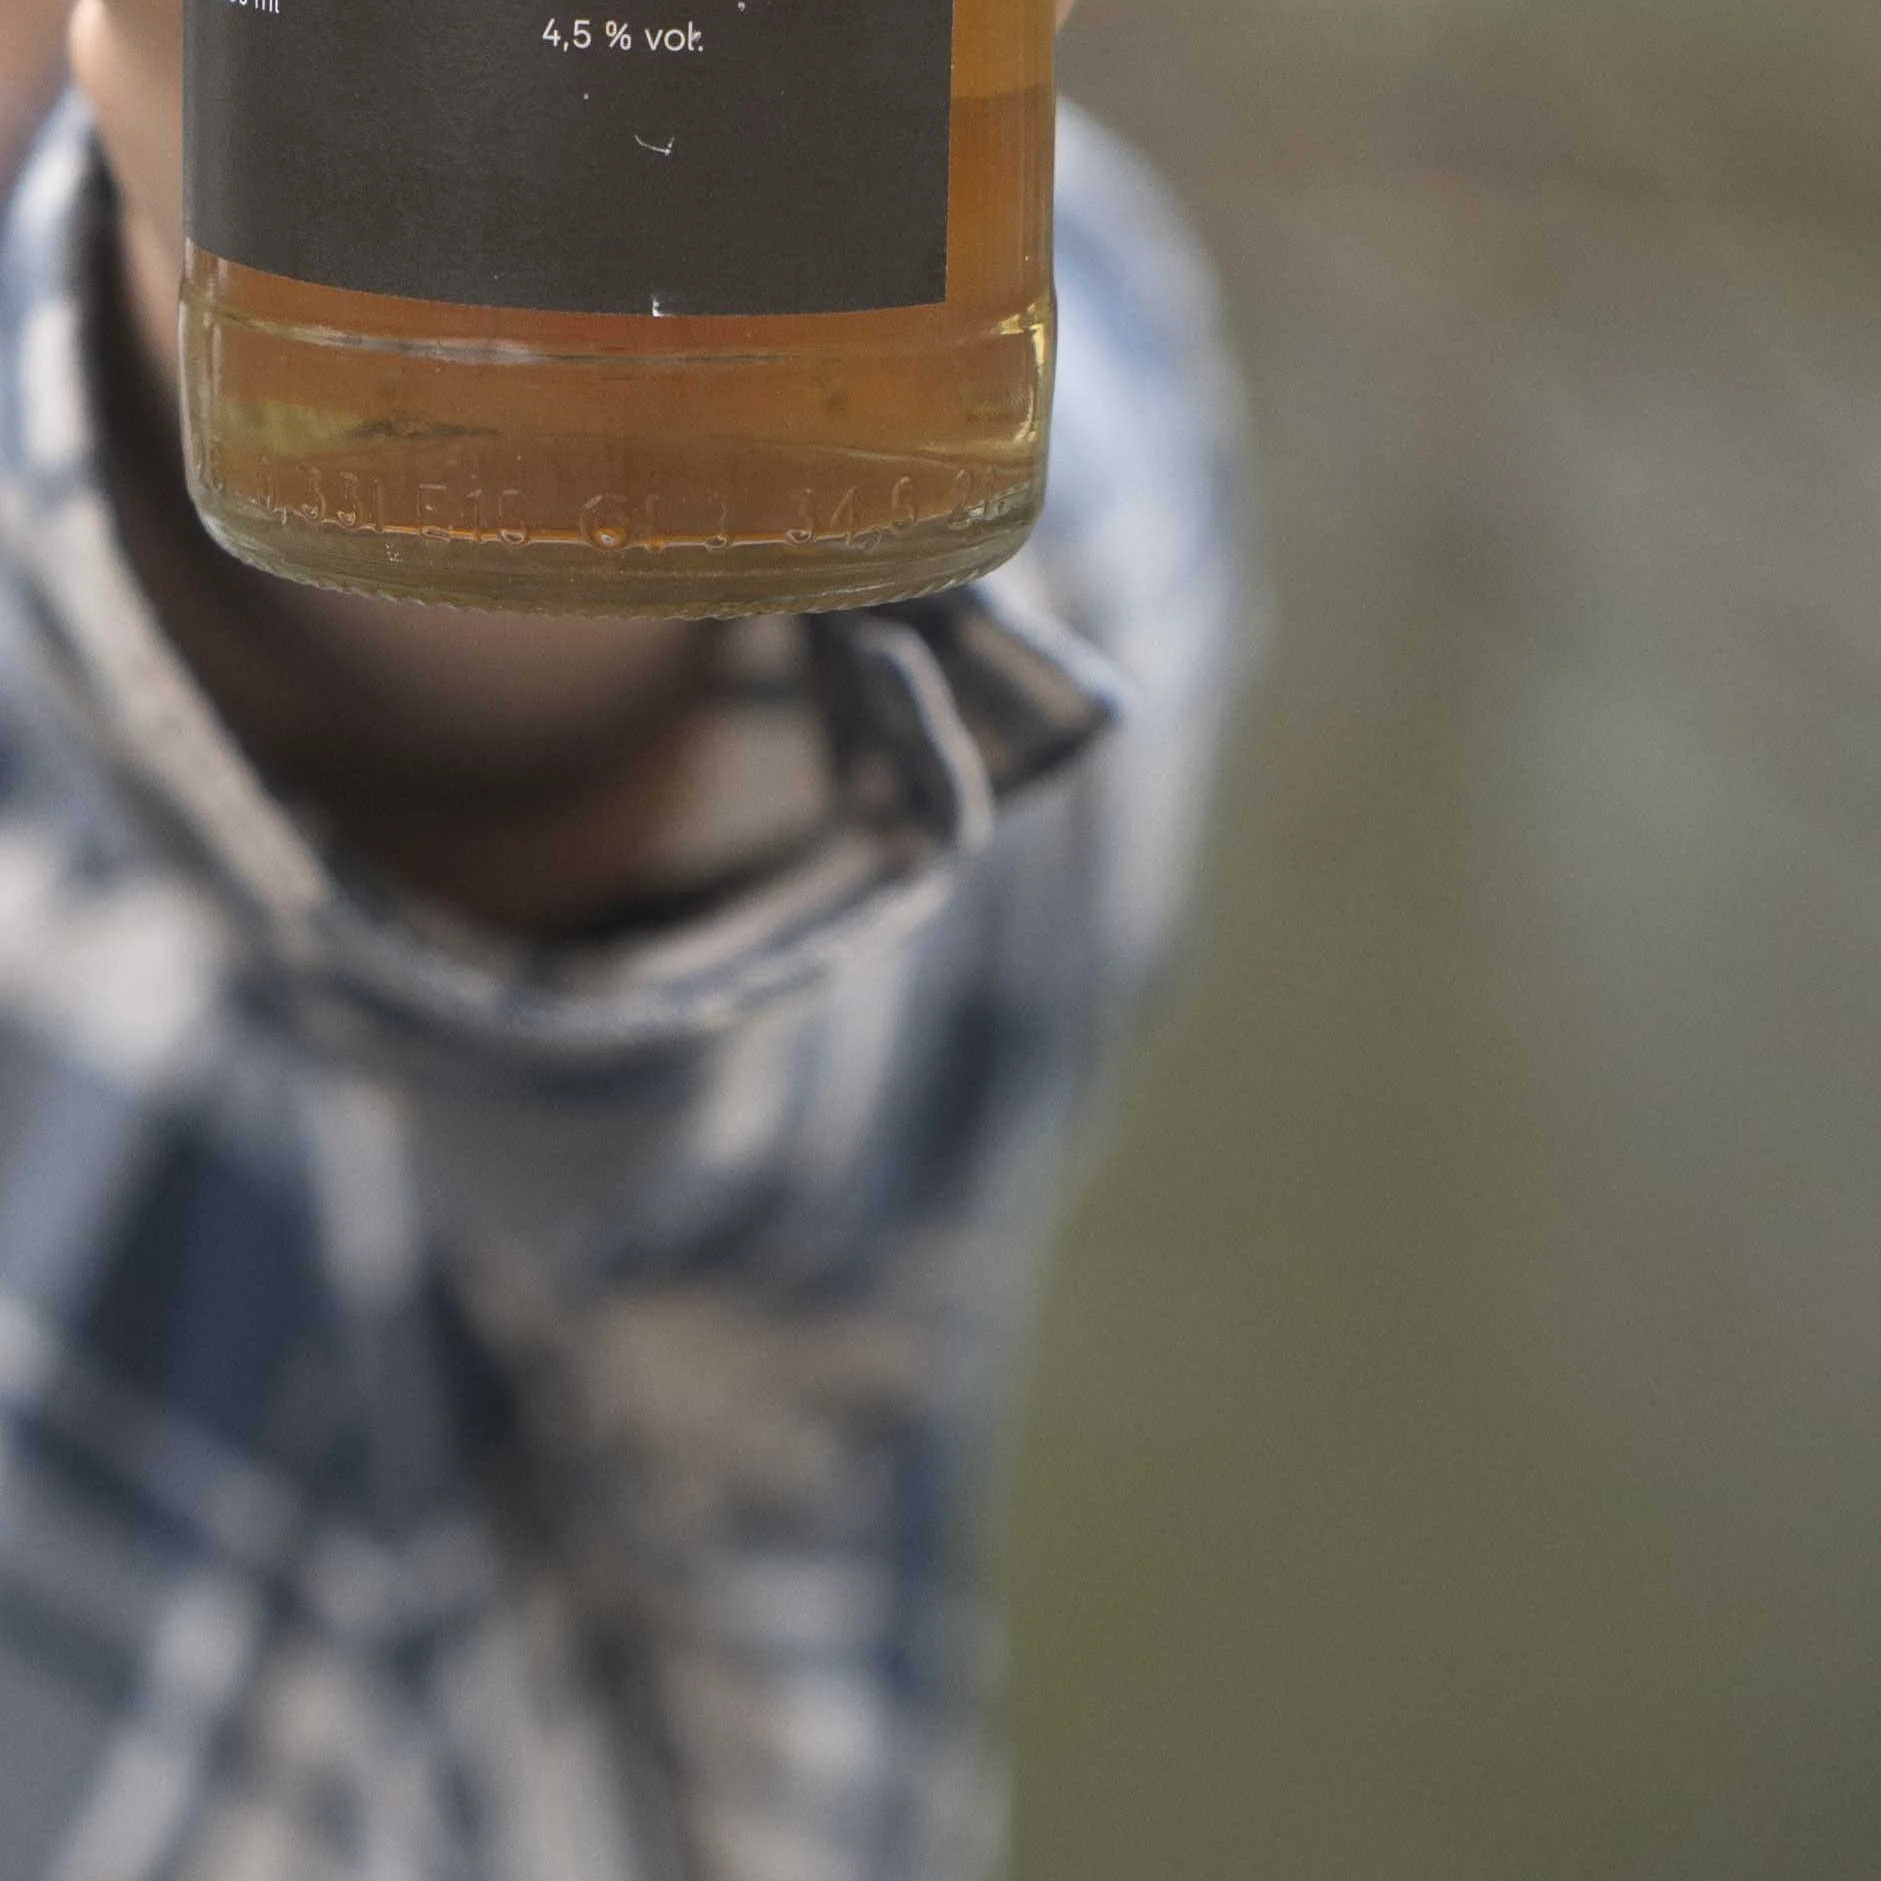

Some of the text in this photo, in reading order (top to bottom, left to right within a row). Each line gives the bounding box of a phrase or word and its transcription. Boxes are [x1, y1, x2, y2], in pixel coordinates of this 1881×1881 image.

[541, 17, 704, 53] 4,5 % vol.
